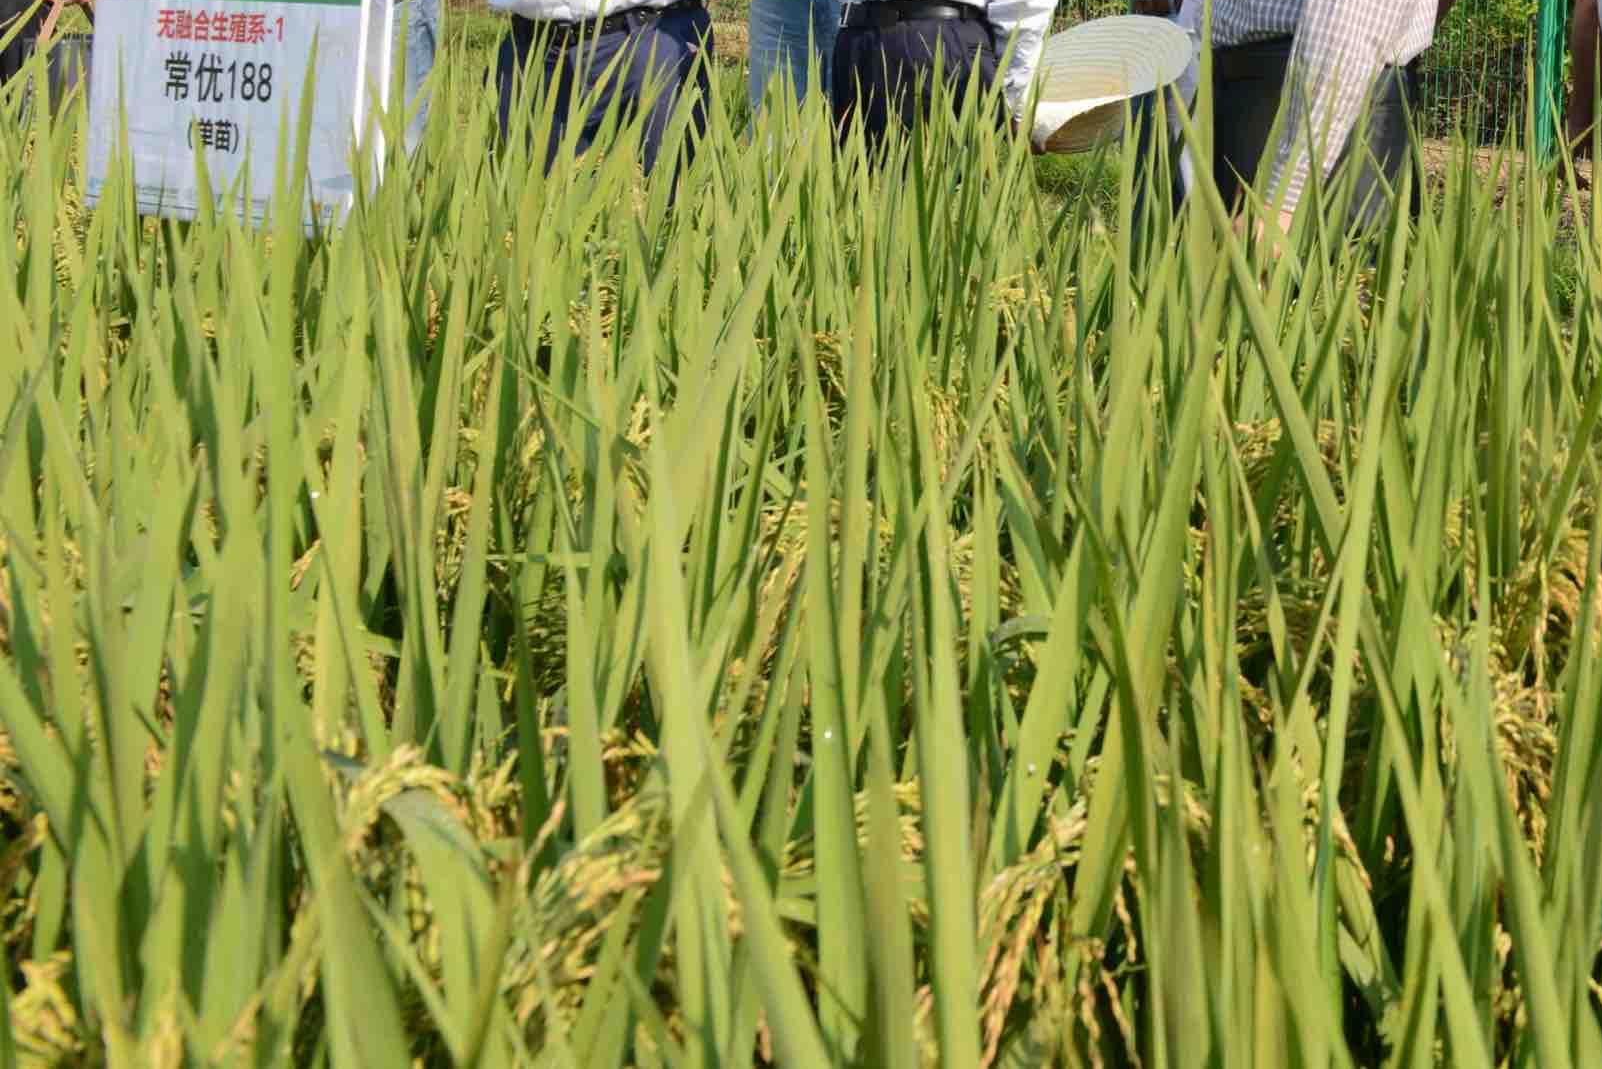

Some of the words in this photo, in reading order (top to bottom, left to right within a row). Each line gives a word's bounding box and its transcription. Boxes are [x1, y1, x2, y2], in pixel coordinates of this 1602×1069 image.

[157, 10, 285, 43] 无融合生殖系-1
[165, 50, 272, 102] 常优188
